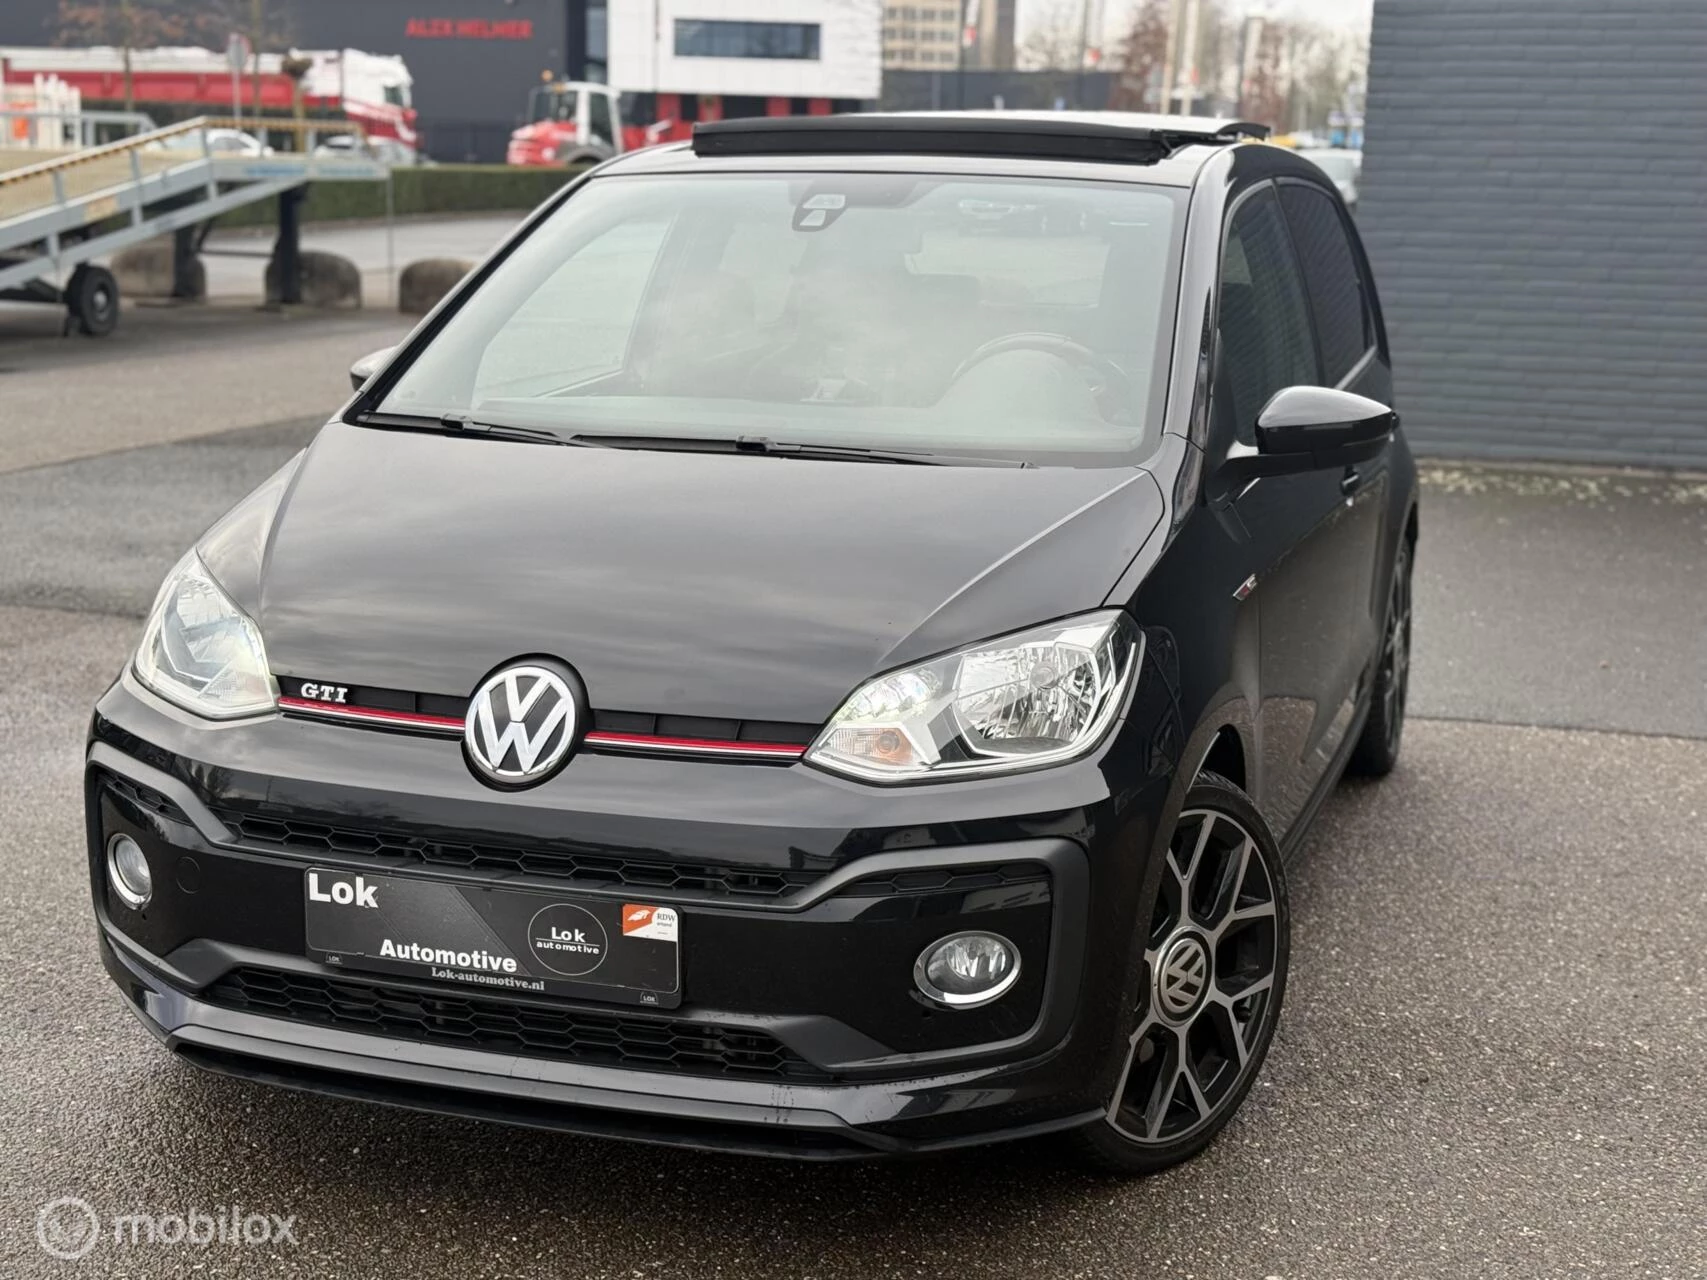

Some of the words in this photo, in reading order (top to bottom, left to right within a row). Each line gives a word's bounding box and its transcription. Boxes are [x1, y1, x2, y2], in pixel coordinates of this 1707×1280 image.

[300, 682, 348, 703] GTI
[308, 872, 378, 908] Lok
[656, 912, 676, 922] RDW
[551, 926, 586, 943] Lok
[380, 939, 518, 973] Automotive
[536, 941, 600, 955] automotive
[431, 966, 545, 991] Lok-automotive.nl
